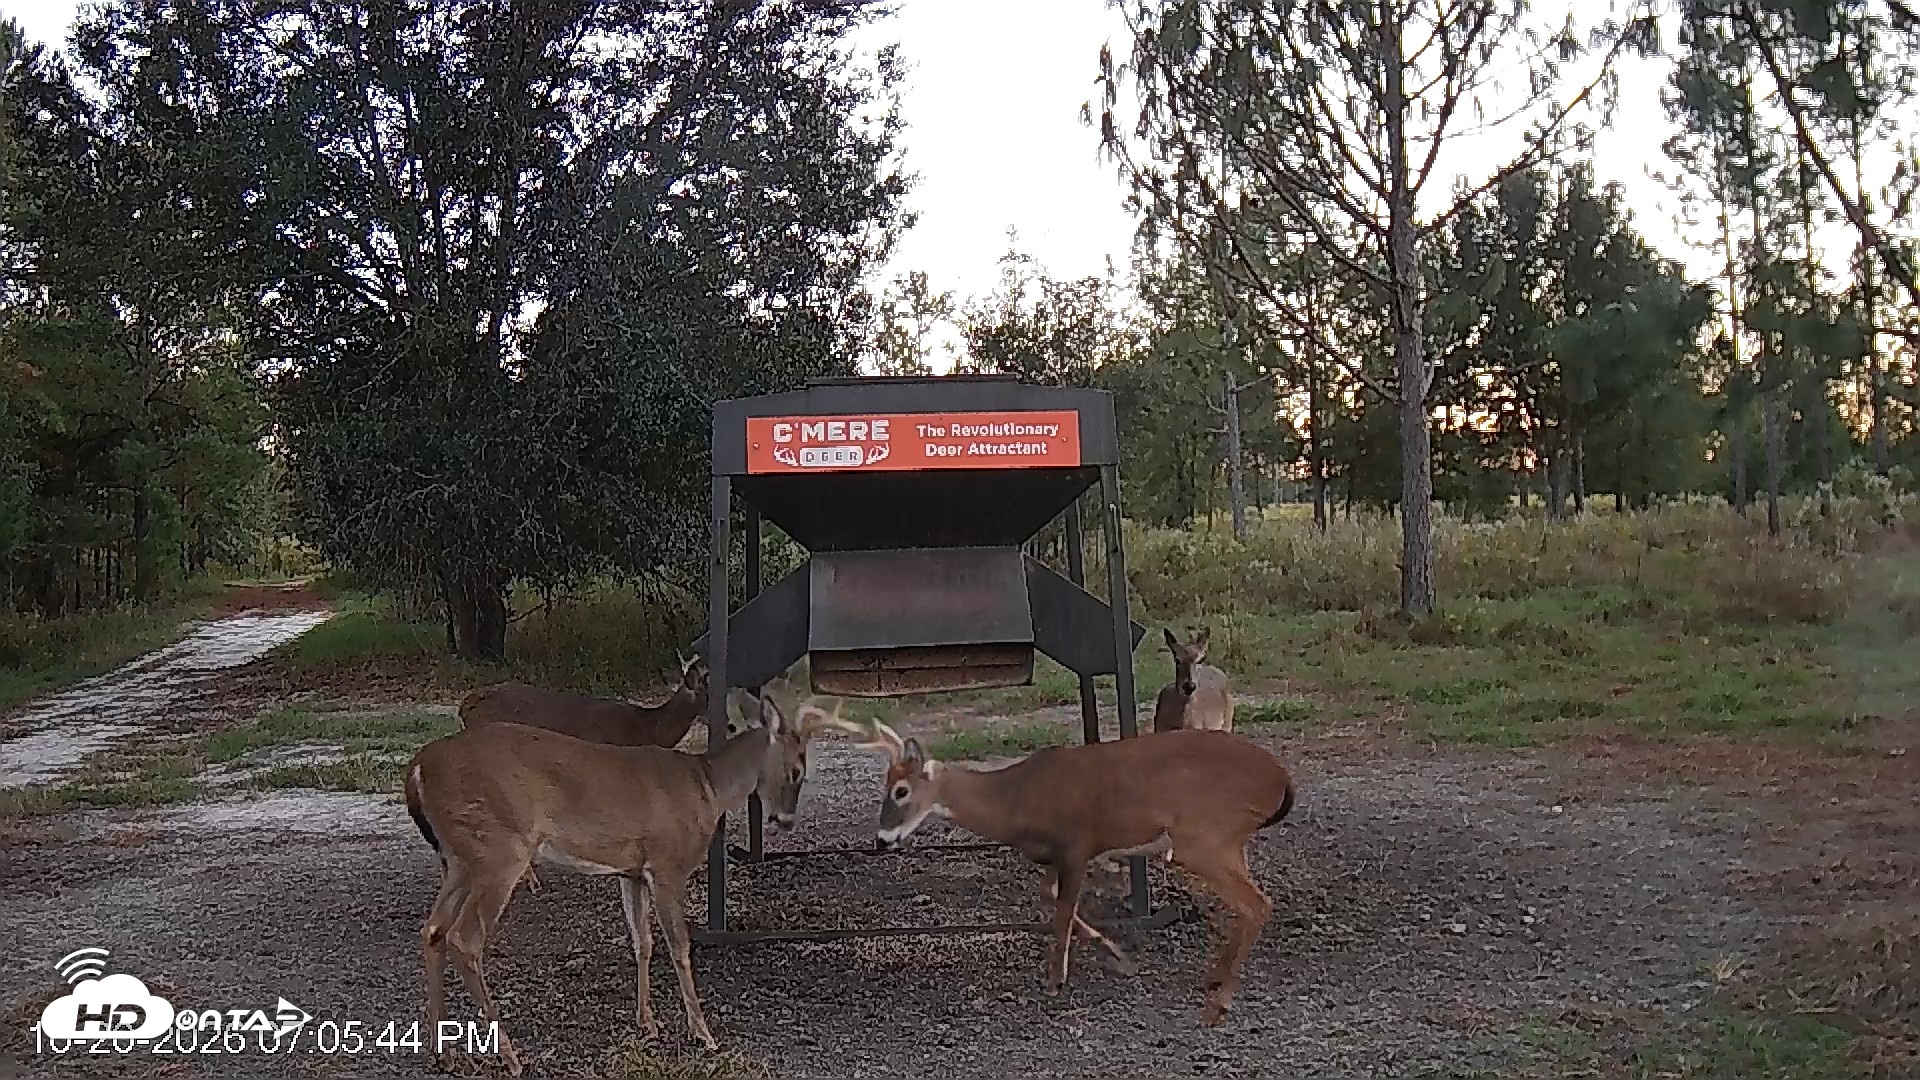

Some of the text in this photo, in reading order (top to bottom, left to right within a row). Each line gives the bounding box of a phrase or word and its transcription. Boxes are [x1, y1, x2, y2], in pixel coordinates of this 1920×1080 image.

[773, 420, 890, 443] C'MERE
[915, 421, 1060, 437] The Revolutionary
[925, 440, 1048, 457] Deer Attractant
[805, 451, 858, 463] DEER
